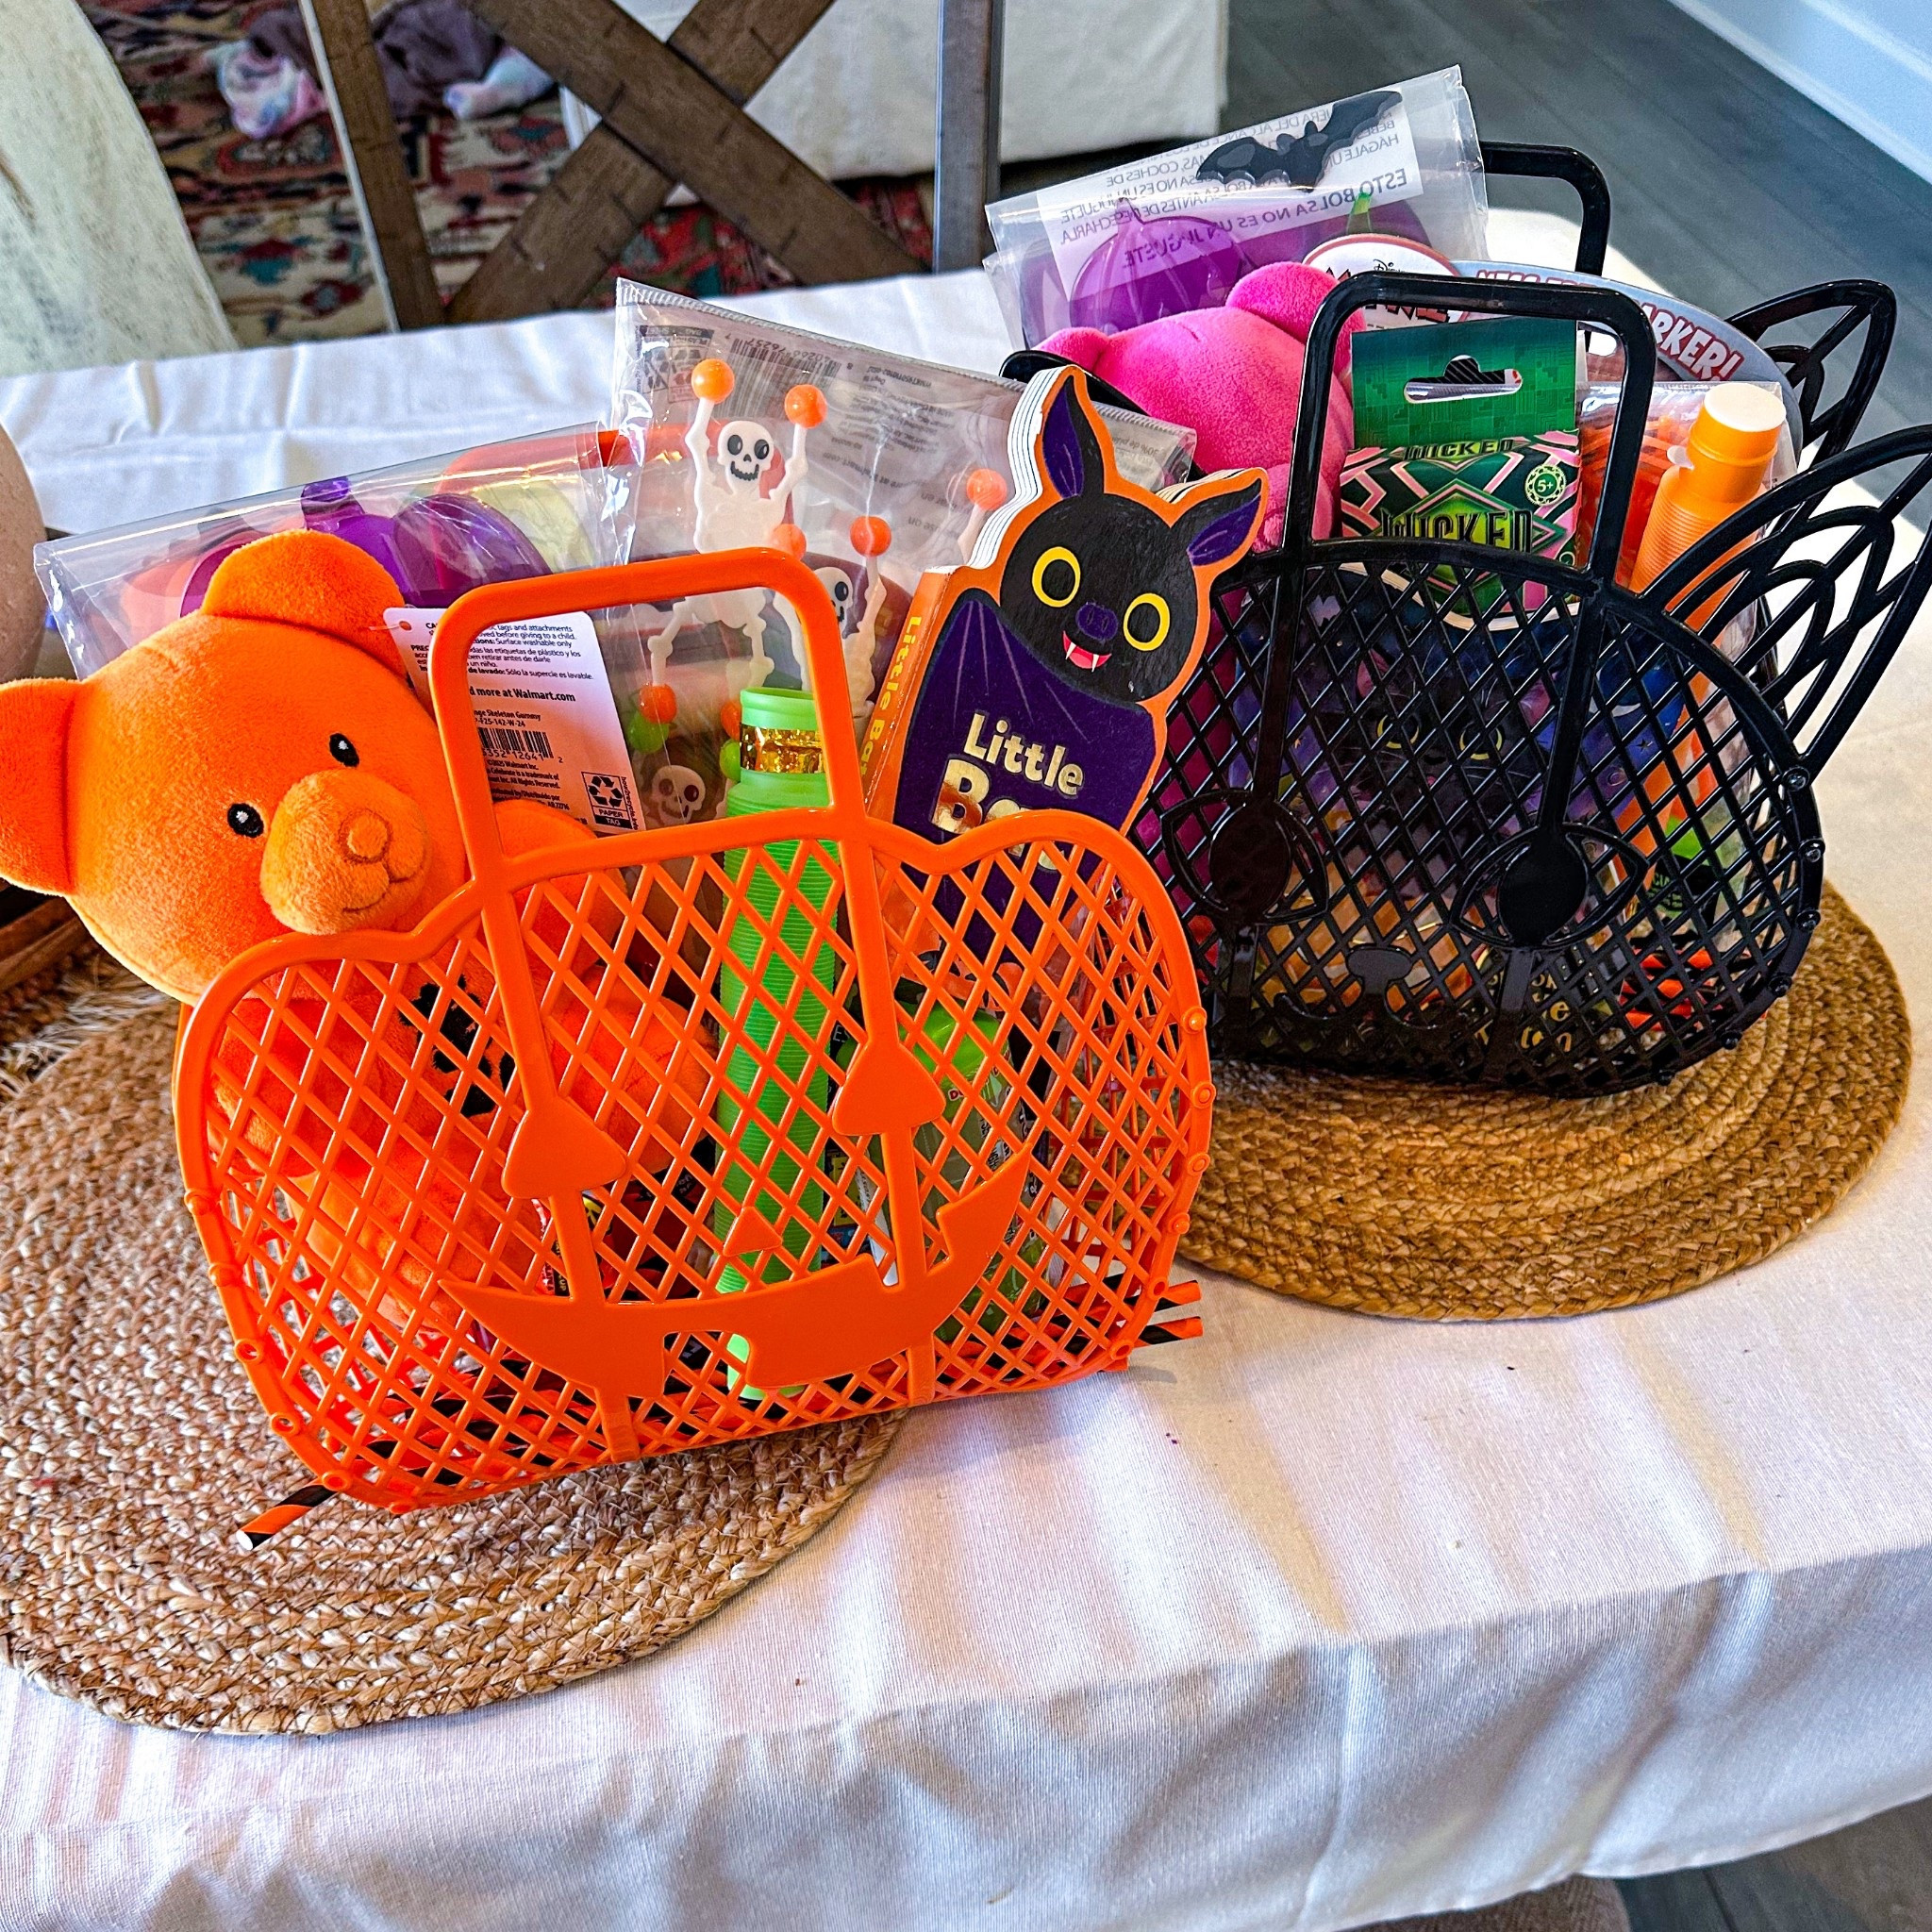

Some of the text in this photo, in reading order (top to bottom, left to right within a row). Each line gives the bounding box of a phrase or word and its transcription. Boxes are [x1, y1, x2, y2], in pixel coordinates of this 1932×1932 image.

[1640, 303, 1744, 381] RKER!
[1403, 438, 1514, 461] WICKED
[1536, 477, 1554, 491] 5+
[529, 625, 573, 633] attachments
[496, 630, 520, 639] before
[520, 632, 542, 641] giving
[557, 641, 573, 649] only
[494, 648, 526, 657] etiquetas
[879, 615, 923, 710] Little
[506, 667, 522, 676] Sólo
[477, 688, 576, 702] more at Walmart.com
[487, 708, 516, 719] Skeleton
[515, 710, 541, 722] Gummy
[963, 711, 1085, 797] Little
[598, 808, 624, 819] PAPER
[605, 817, 622, 826] TAG
